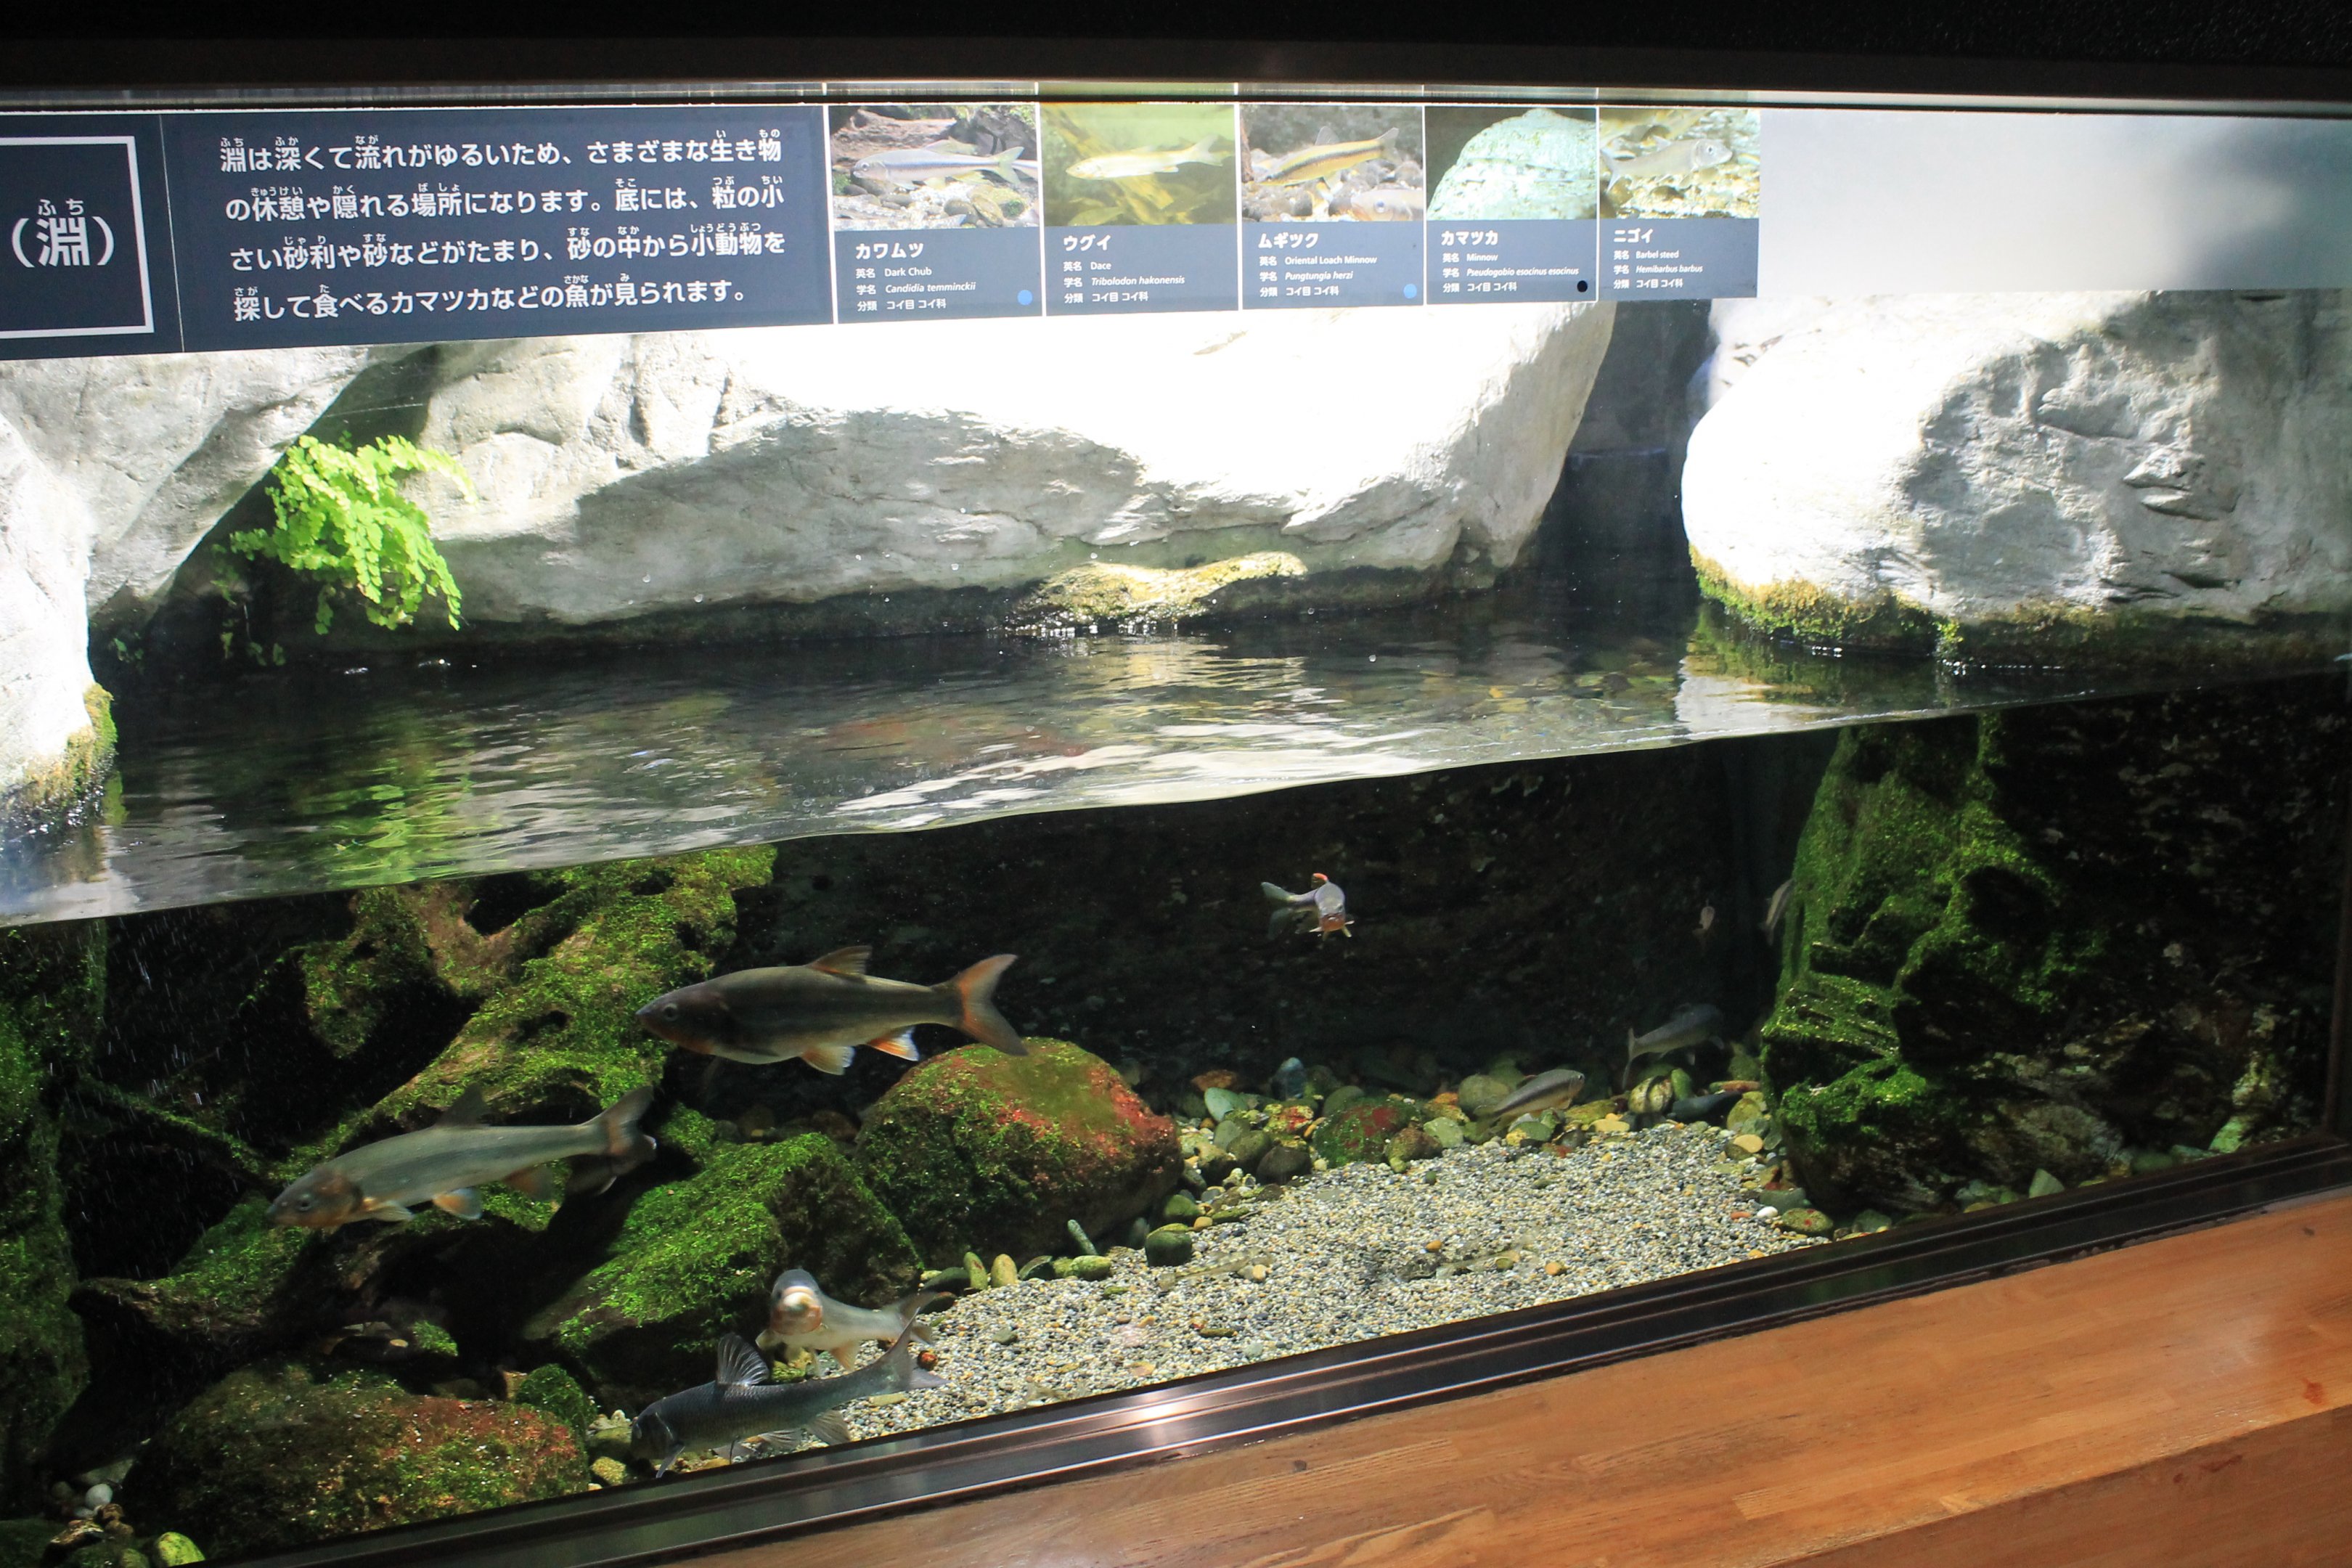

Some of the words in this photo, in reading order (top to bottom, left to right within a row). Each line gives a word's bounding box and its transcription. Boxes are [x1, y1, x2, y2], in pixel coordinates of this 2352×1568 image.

[38, 197, 86, 216] ふち
[1257, 232, 1319, 249] ムギツク
[1441, 229, 1498, 245] カマツカ
[1613, 227, 1654, 244] ニゴイ
[1063, 234, 1111, 251] ウグイ
[855, 242, 924, 260] カワムツ
[1613, 250, 1630, 260] 英名
[1259, 256, 1277, 266] 英名
[1285, 256, 1318, 265] Oriental
[1319, 256, 1343, 265] Loach
[1344, 255, 1378, 264] Minnow
[1442, 253, 1460, 263] 英名
[1466, 253, 1498, 262] Minnow
[1063, 261, 1082, 271] 英名
[1090, 261, 1111, 270] Dace
[1442, 268, 1460, 278] 学名
[1466, 267, 1515, 278] Pseudogobio
[1516, 266, 1547, 276] esocinus
[1548, 266, 1580, 275] esocinus
[1613, 264, 1630, 275] 学名
[1636, 265, 1678, 274] Hemibarbus
[1679, 264, 1703, 273] barbus
[855, 268, 875, 279] 英名
[884, 268, 906, 277] Dark
[908, 267, 932, 277] Chub
[1259, 271, 1278, 282] 学名
[1285, 271, 1331, 282] Pungtungia
[1333, 270, 1354, 279] herzi
[1063, 277, 1082, 287] 学名
[1091, 277, 1137, 287] Tribolodon
[1138, 275, 1185, 285] hakonensis
[1442, 282, 1460, 293] 分類
[1467, 282, 1490, 292] コイ目
[1493, 281, 1517, 292] コイ科
[1613, 279, 1630, 290] 分類
[1636, 279, 1659, 289] コイ目
[1660, 278, 1683, 288] コイ科
[856, 285, 876, 295] 学名
[885, 284, 925, 293] Candidia
[926, 282, 976, 292] temminckii
[1259, 287, 1278, 298] 分類
[1286, 286, 1311, 297] コイ目
[1314, 285, 1339, 295] コイ科
[1064, 293, 1083, 304] 分類
[1092, 292, 1119, 302] コイ目
[1122, 291, 1148, 302] コイ科
[857, 301, 878, 312] 分類
[886, 300, 915, 310] コイ目
[918, 298, 947, 309] コイ科
